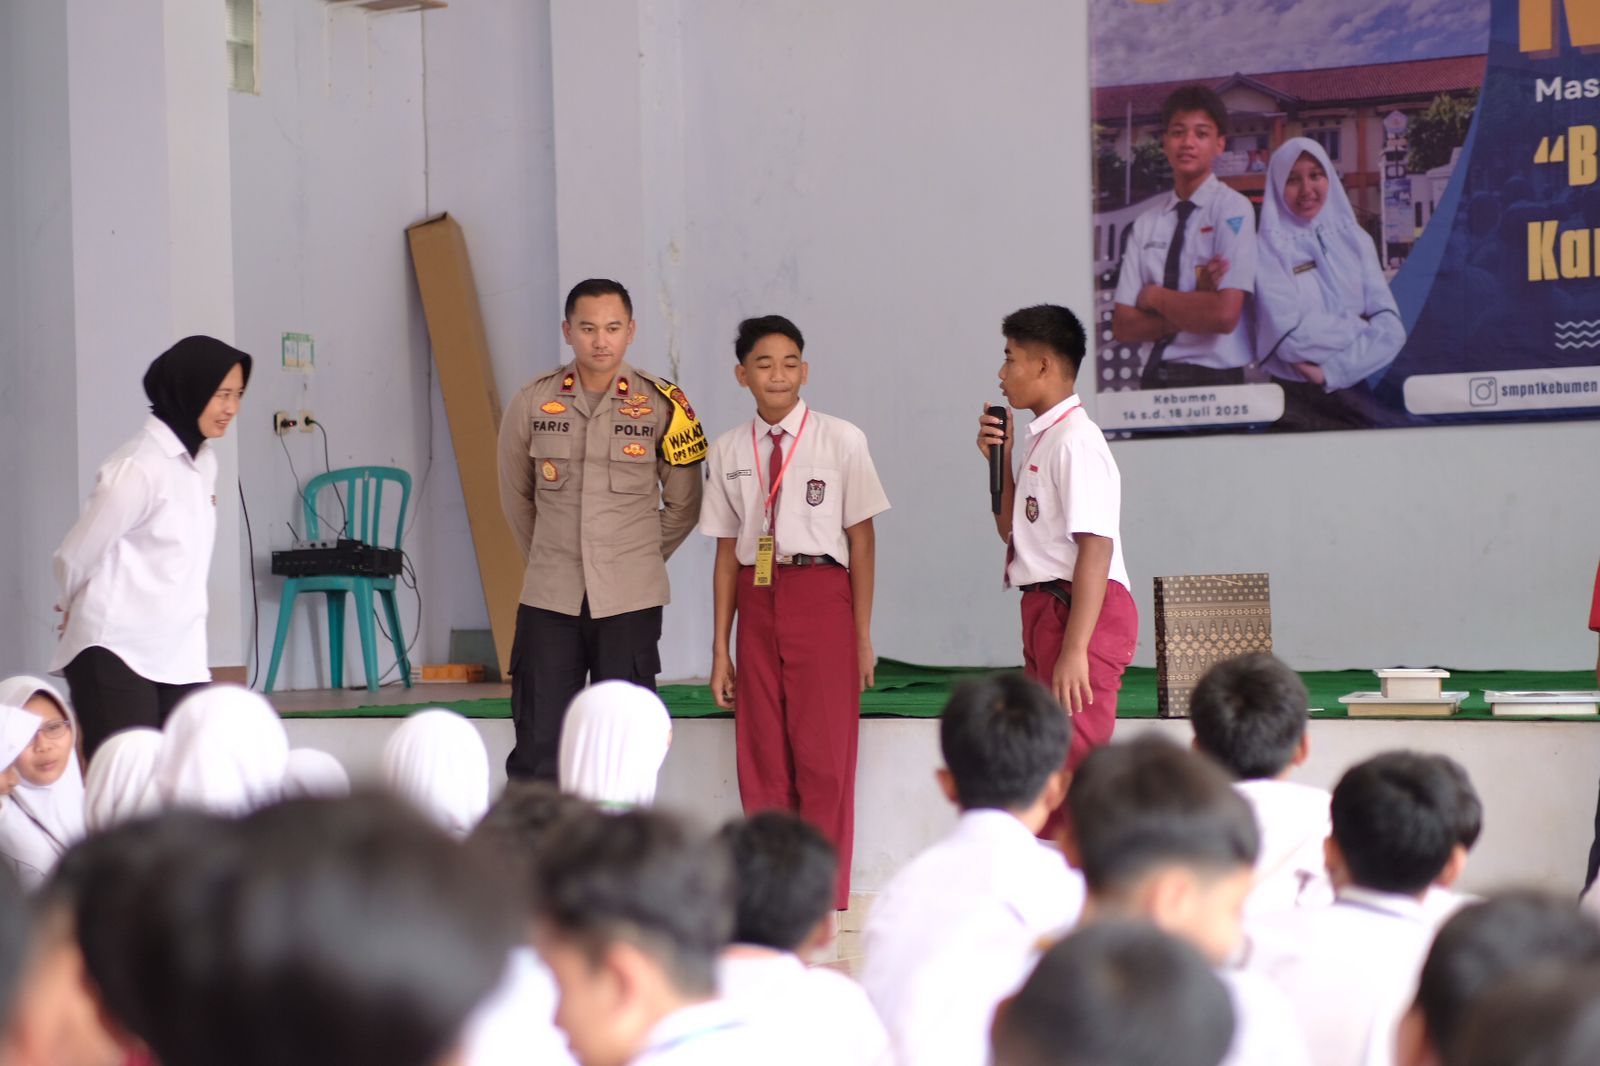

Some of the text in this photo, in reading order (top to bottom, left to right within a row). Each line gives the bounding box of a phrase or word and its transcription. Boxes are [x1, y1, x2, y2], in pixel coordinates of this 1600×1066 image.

[1535, 76, 1600, 103] Mas
[1501, 381, 1599, 398] smpn1kebumen
[1153, 393, 1217, 405] Kebumen
[1123, 411, 1137, 421] 14
[1187, 406, 1211, 417] Juli
[1215, 405, 1250, 417] 2025
[533, 421, 570, 433] FARIS
[614, 424, 654, 437] POLRI
